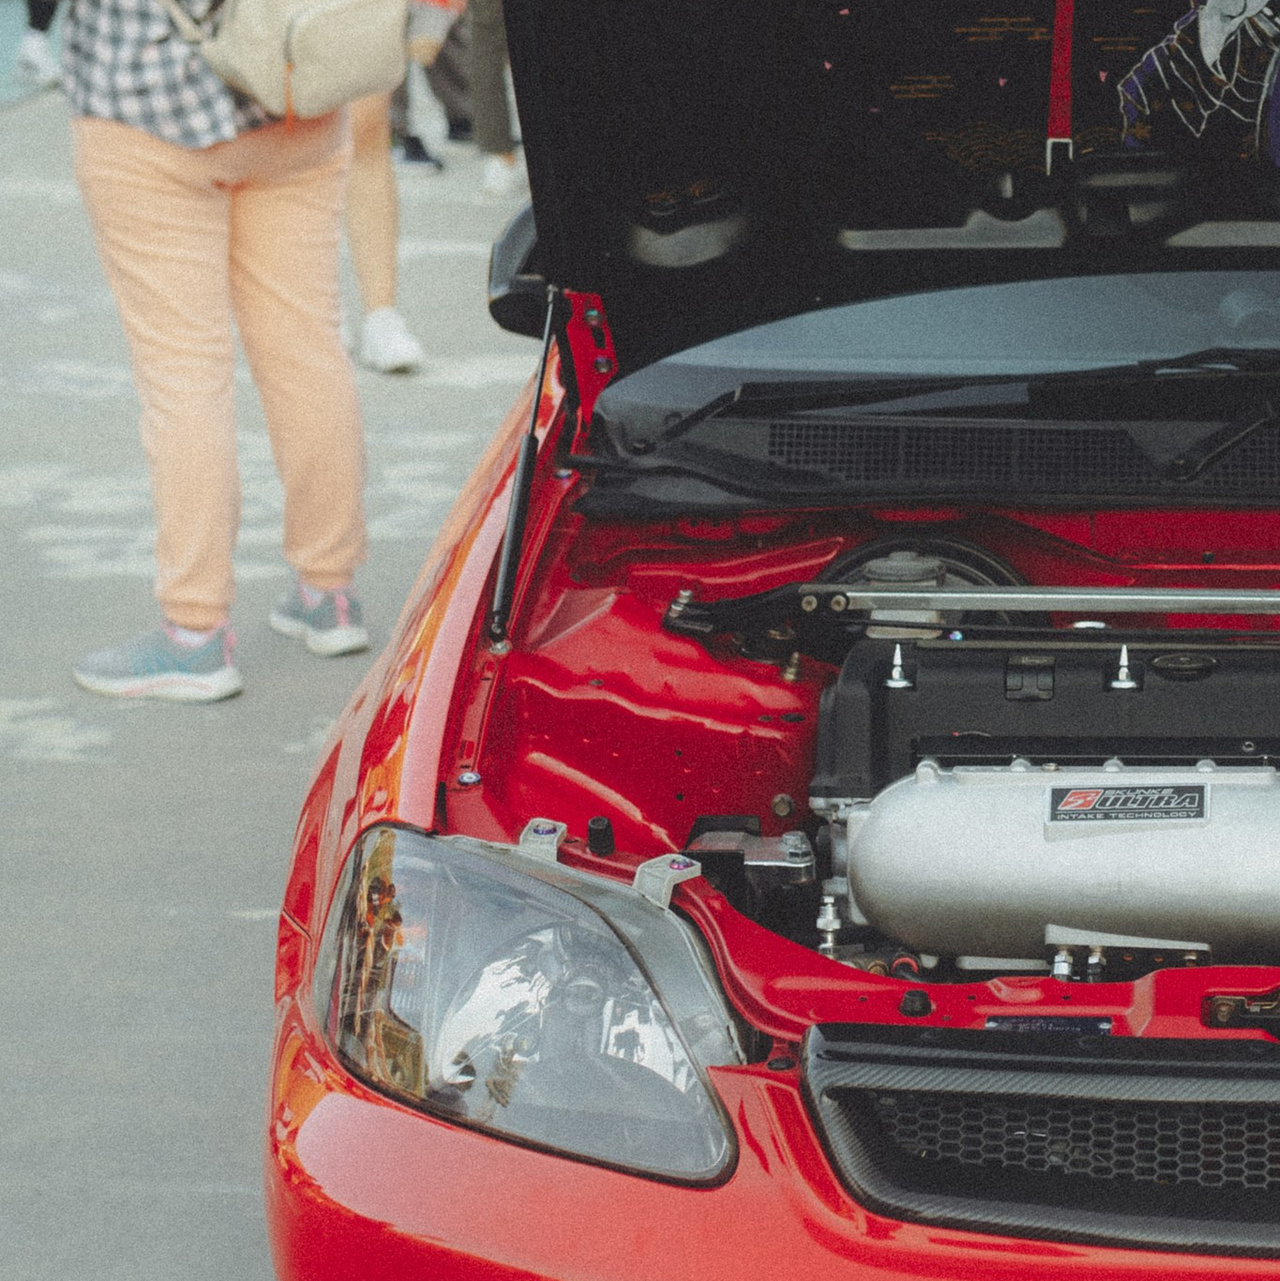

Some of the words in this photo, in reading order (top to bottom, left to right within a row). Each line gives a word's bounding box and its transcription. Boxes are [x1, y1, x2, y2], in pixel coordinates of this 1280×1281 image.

[1095, 793, 1199, 809] ULTRA
[1057, 812, 1105, 820] INTAKE
[1109, 811, 1197, 819] TECHNOLOGY
